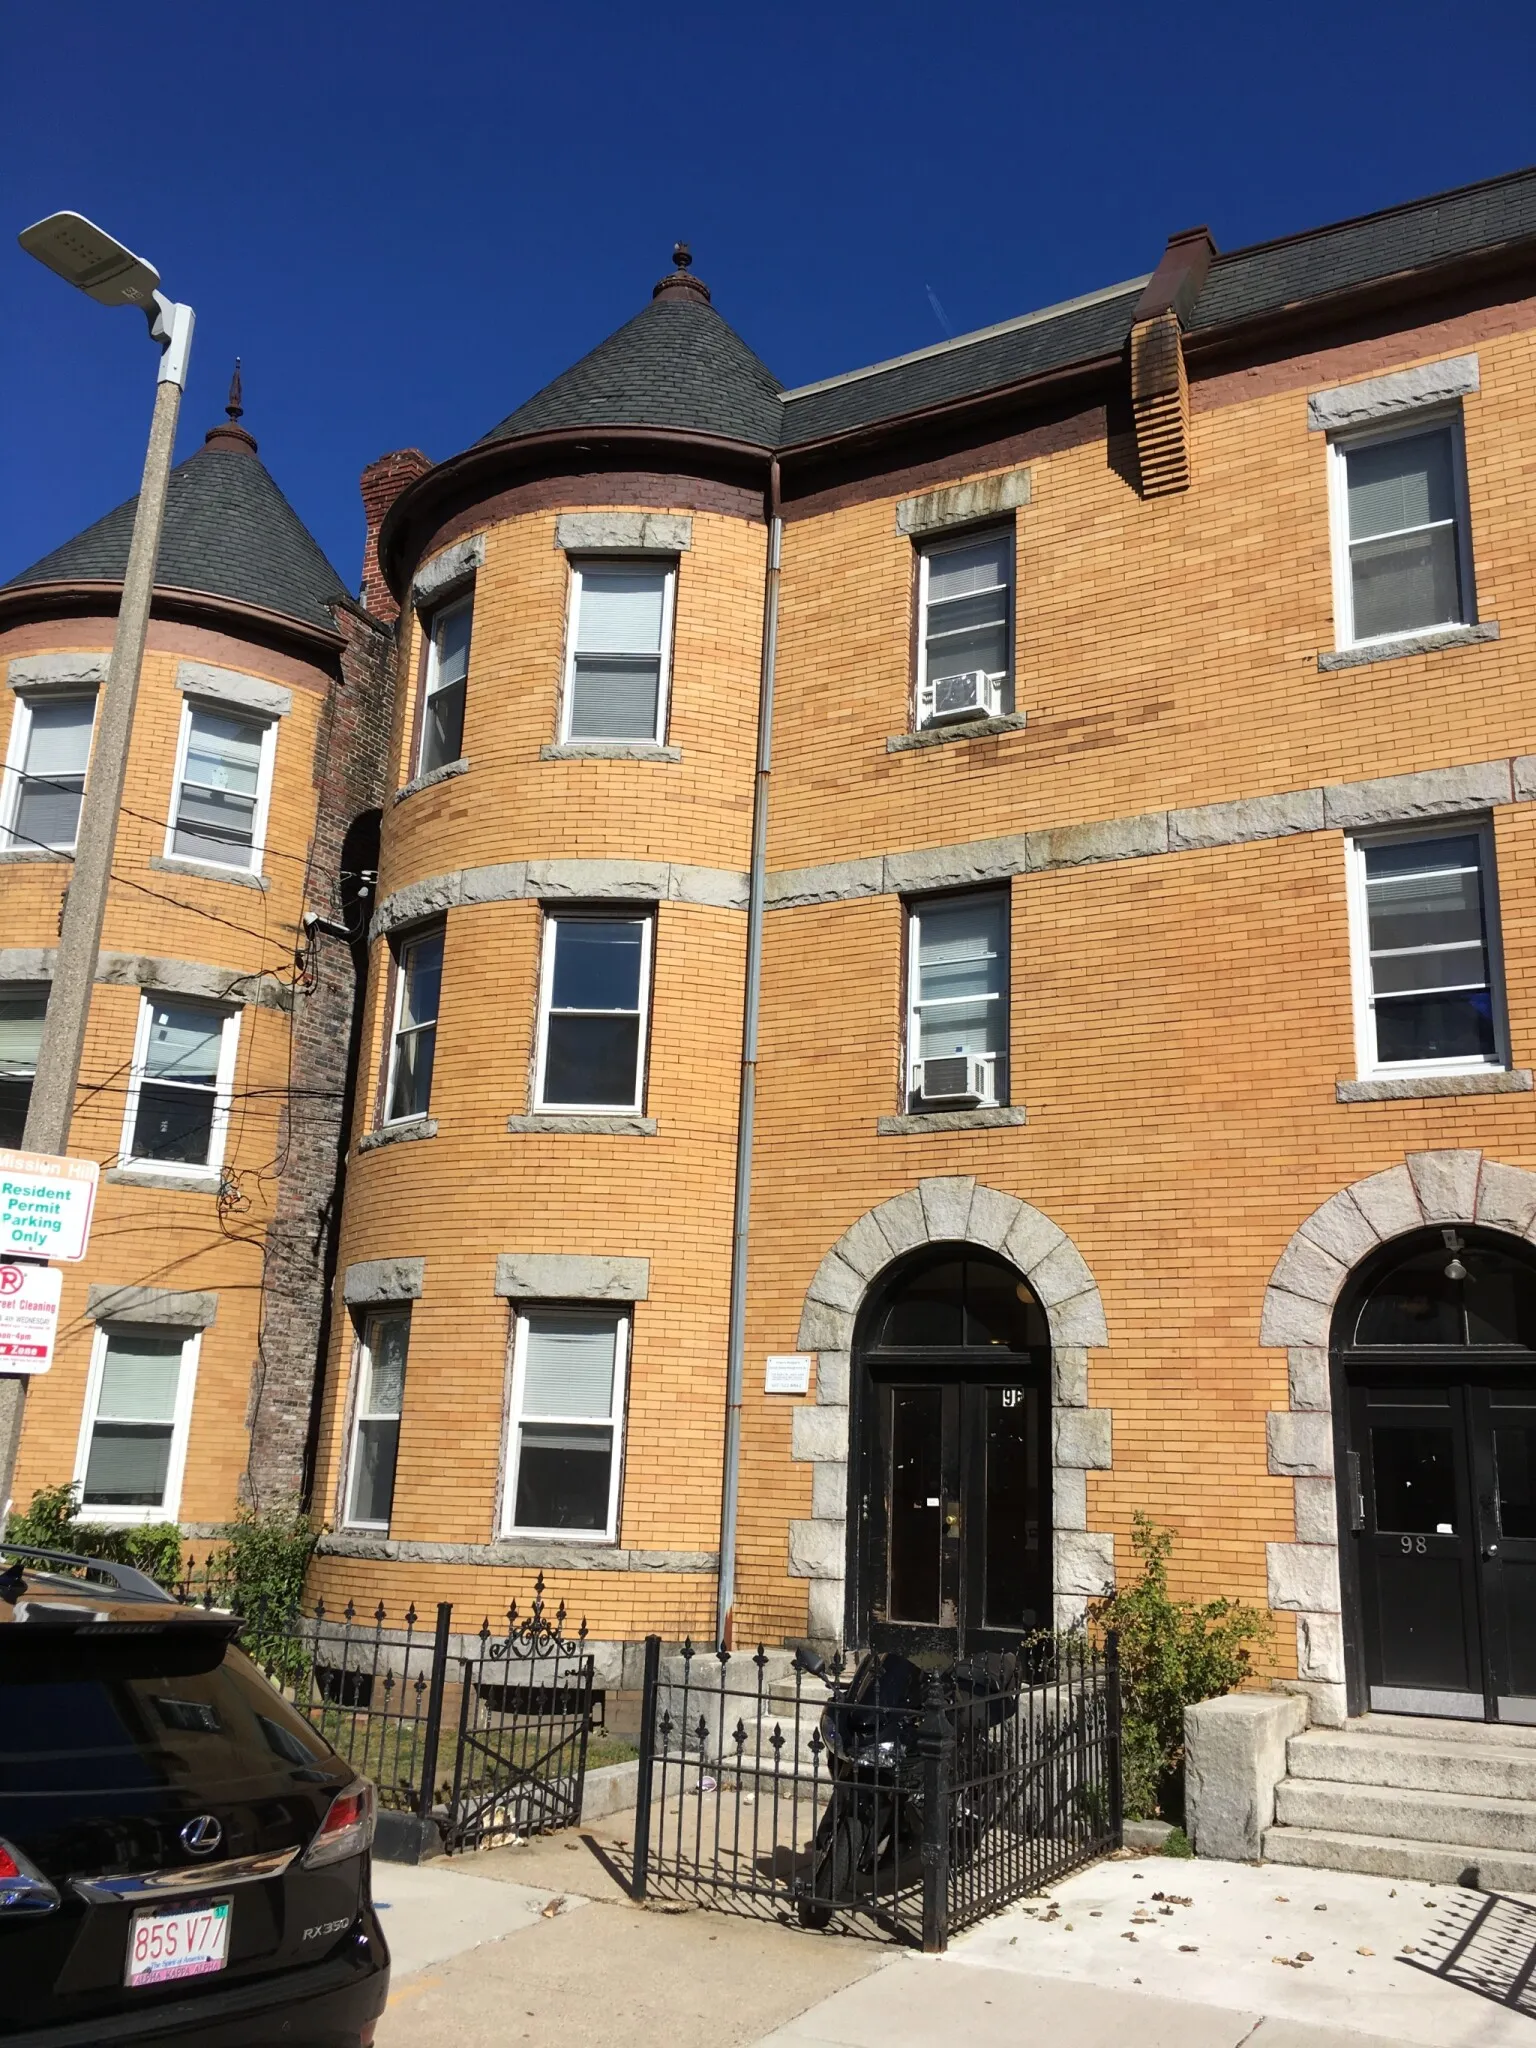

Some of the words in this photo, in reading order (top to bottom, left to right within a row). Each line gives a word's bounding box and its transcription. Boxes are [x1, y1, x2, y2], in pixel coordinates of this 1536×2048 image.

[68, 1163, 96, 1180] Hill
[1, 1182, 72, 1201] Resident
[8, 1198, 61, 1215] Permit
[2, 1213, 62, 1233] Parking
[12, 1229, 48, 1246] Only
[19, 1299, 56, 1314] Cleaning
[10, 1344, 38, 1356] Zone
[1400, 1535, 1428, 1554] 98
[135, 1922, 179, 1961] 85S
